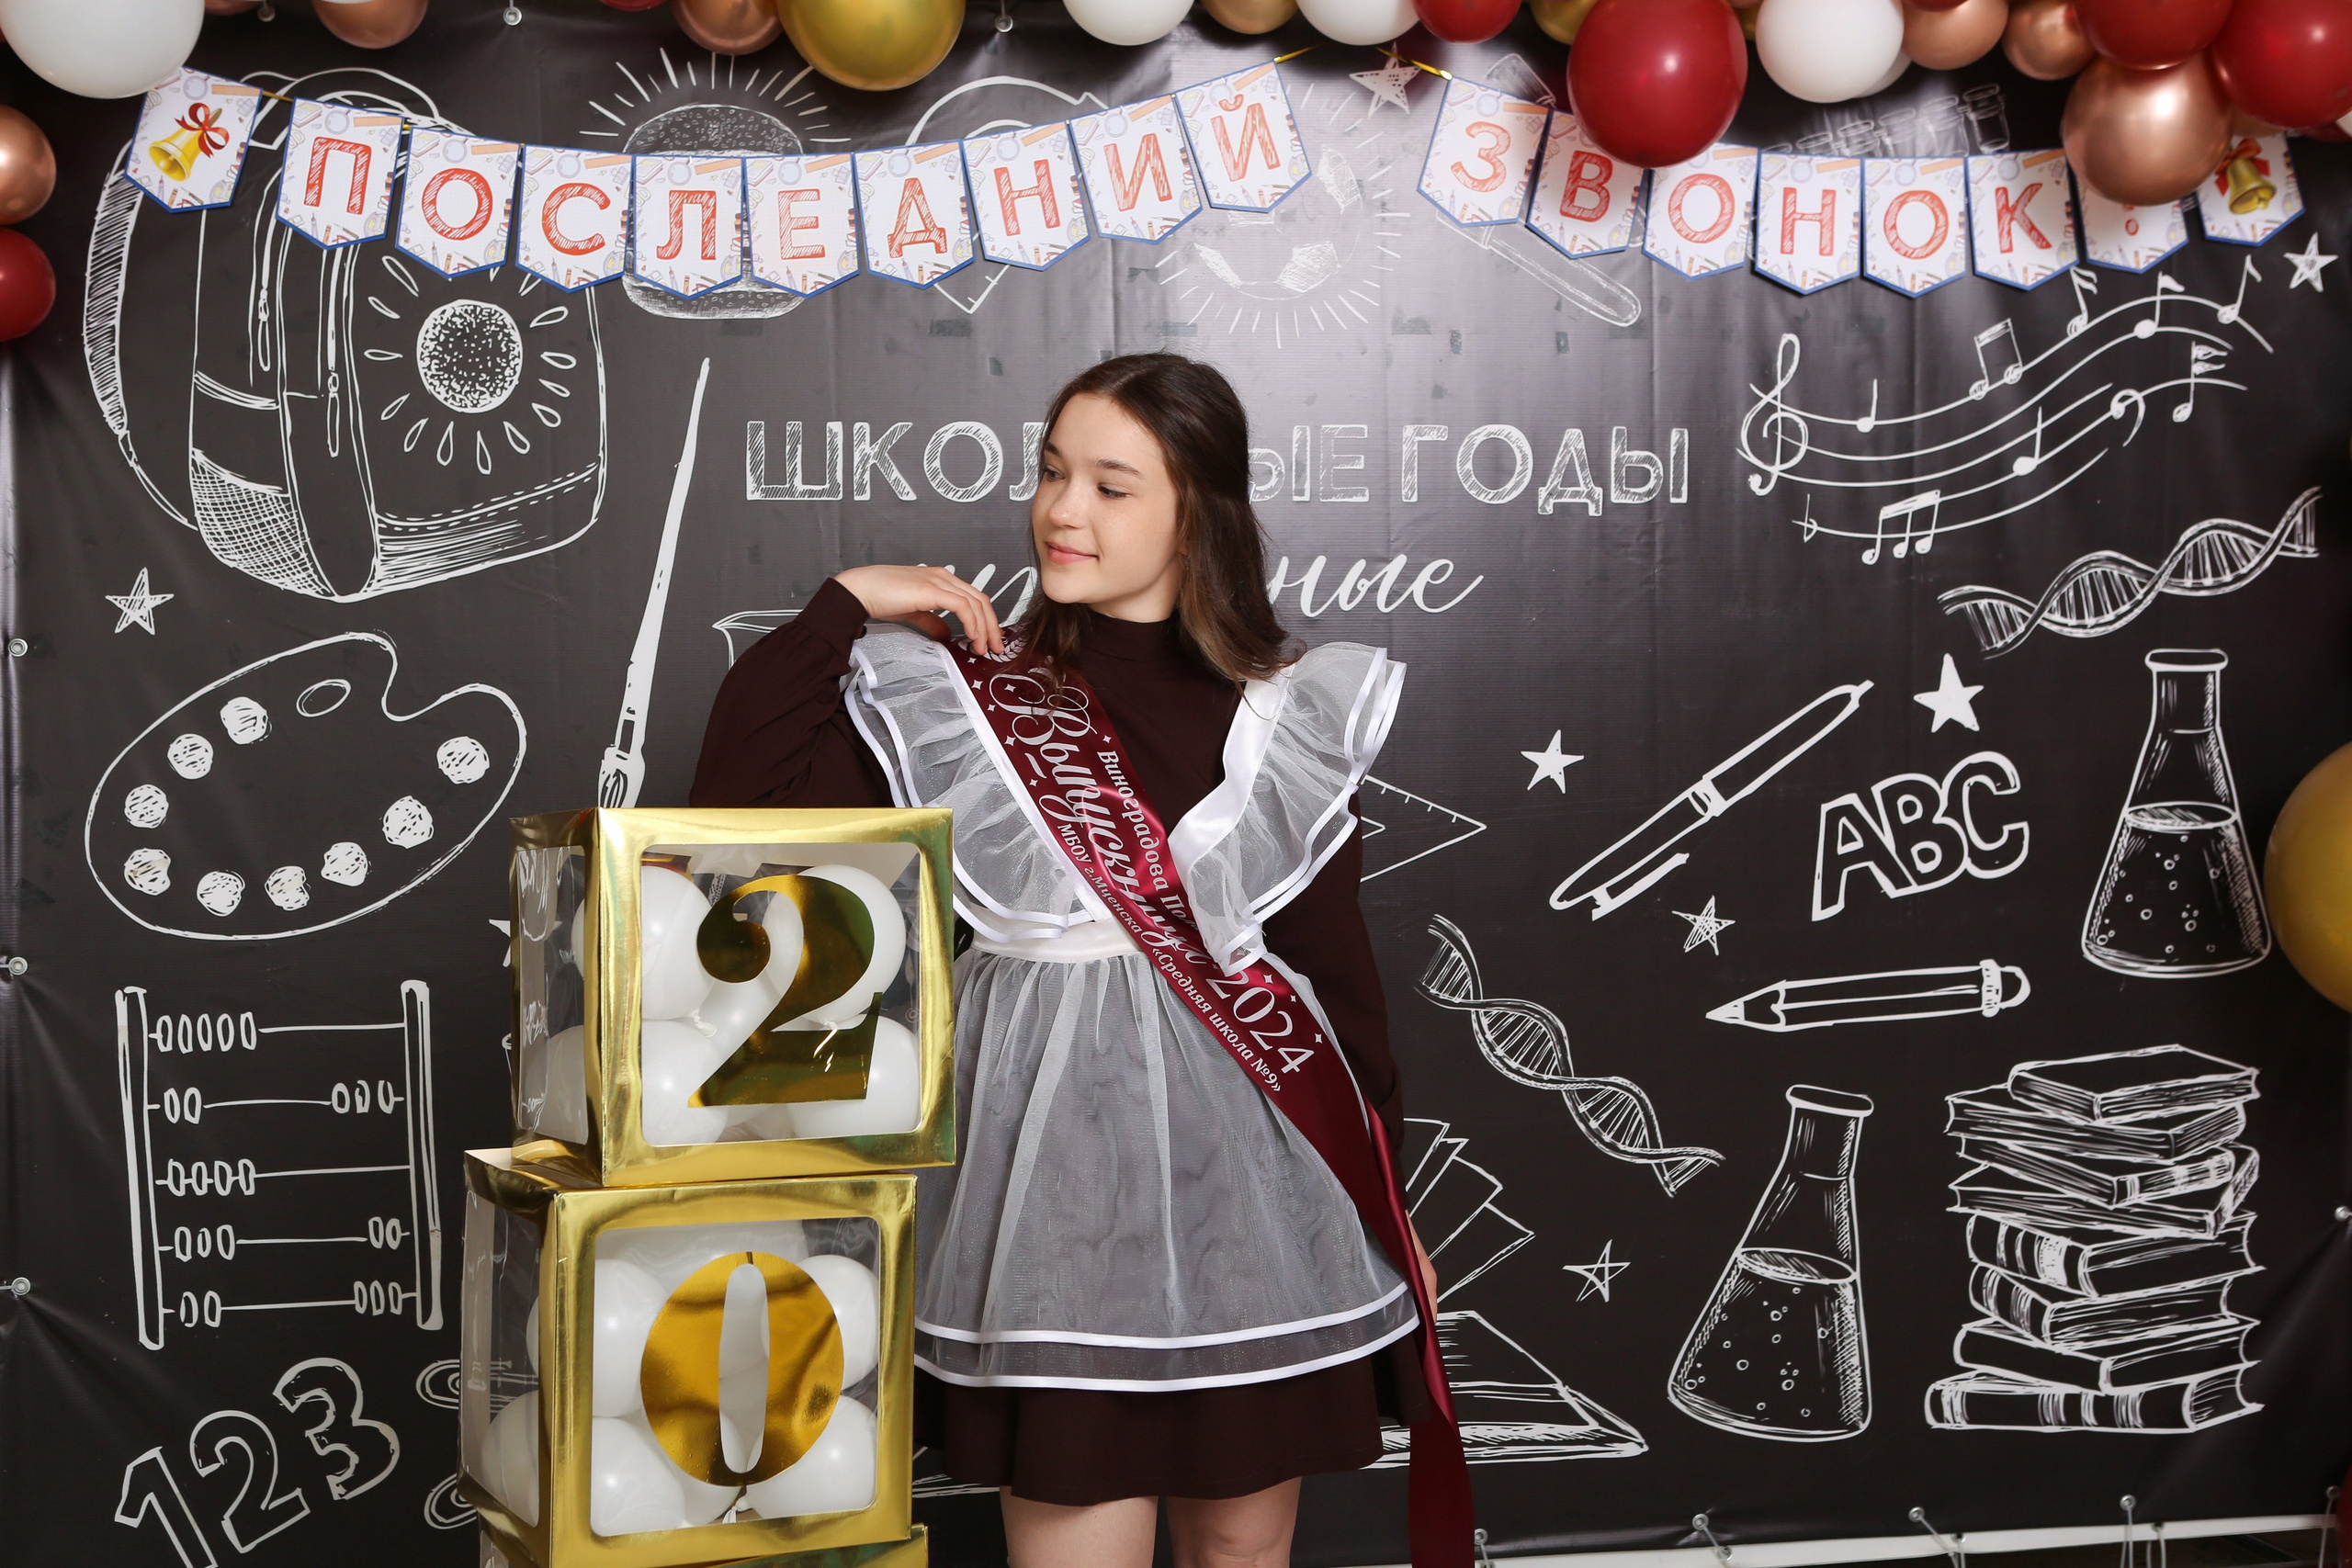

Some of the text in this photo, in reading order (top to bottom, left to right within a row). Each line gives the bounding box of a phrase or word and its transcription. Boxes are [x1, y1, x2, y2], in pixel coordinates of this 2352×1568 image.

[304, 95, 1282, 261] ПОСЛЕДНИЙ
[1402, 423, 1688, 515] ГОДЫ
[1097, 750, 1170, 891] Виноградова
[1811, 750, 2030, 922] ABC
[687, 874, 883, 1108] 2
[1057, 823, 1092, 874] МБОУ
[1152, 948, 1213, 1014] «Средняя
[1208, 1010, 1255, 1061] школа
[1250, 1057, 1282, 1092] №9»
[1206, 971, 1315, 1074] 2024
[114, 1357, 401, 1568] 123
